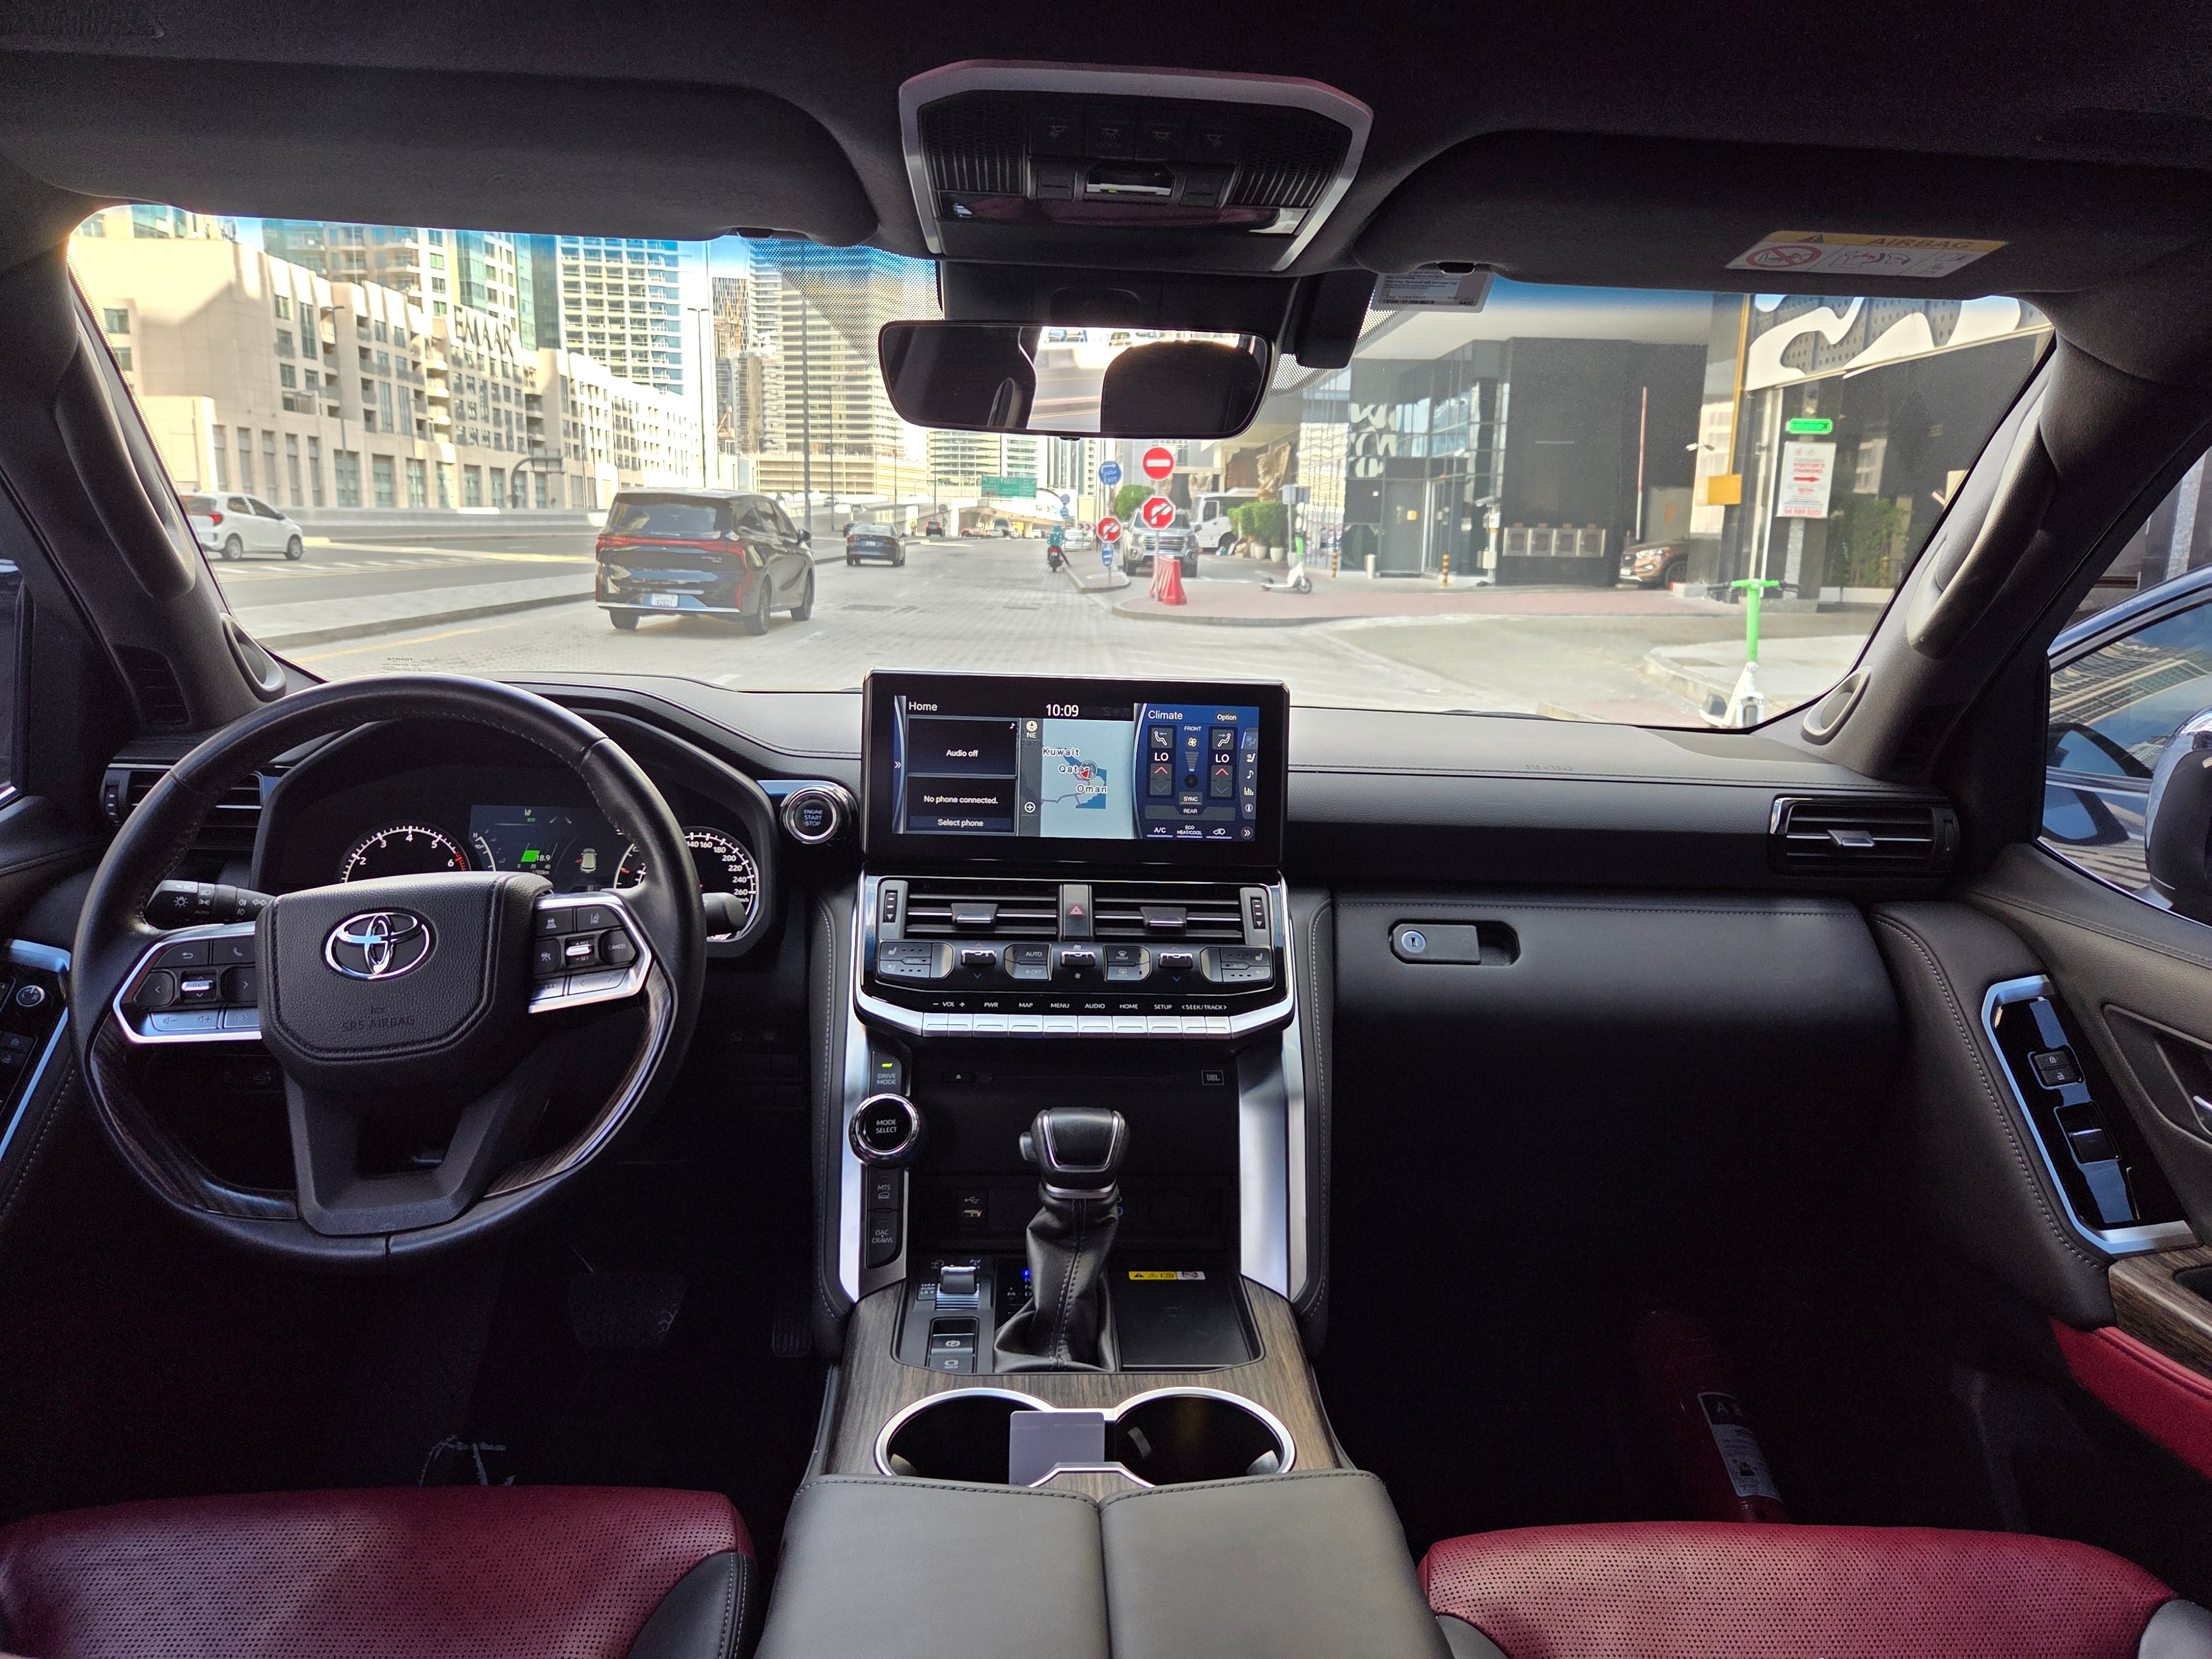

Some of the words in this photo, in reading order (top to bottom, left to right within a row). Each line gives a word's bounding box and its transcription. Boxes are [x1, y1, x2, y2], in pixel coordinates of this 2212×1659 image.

[1866, 238, 1977, 249] AIRBAG
[909, 702, 938, 711] Home
[1046, 704, 1079, 717] 10:09
[1148, 710, 1183, 720] Climate
[1043, 748, 1079, 757] Kuwait
[1154, 752, 1169, 761] LO
[1215, 754, 1230, 763] LO
[1077, 785, 1108, 793] Oman
[936, 796, 958, 804] phone
[961, 820, 984, 828] phone
[405, 834, 413, 842] 4
[359, 857, 367, 865] 2
